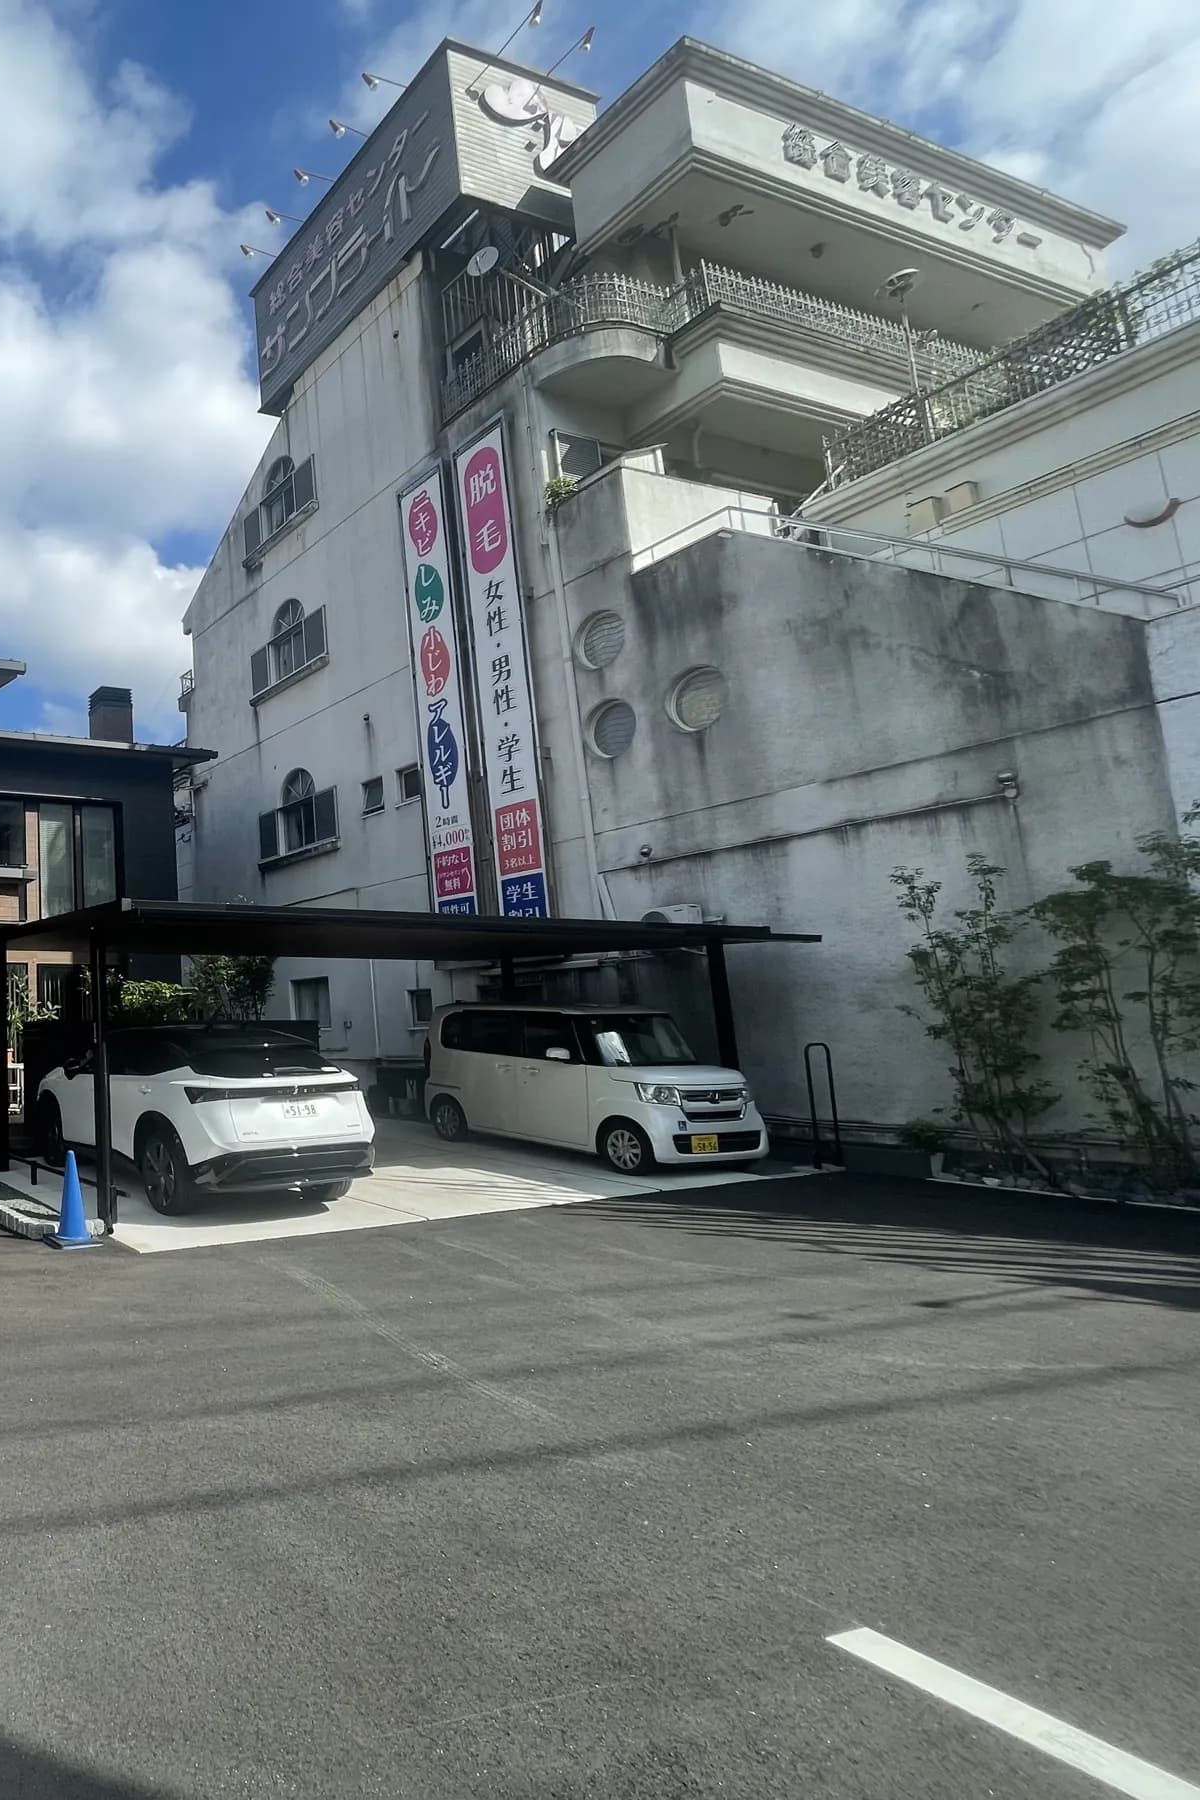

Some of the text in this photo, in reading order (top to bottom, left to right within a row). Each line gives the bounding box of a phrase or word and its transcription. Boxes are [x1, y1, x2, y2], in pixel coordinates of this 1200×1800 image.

[269, 111, 430, 316] 総合美容センター
[412, 490, 432, 556] ニキビ
[468, 463, 502, 553] 脱毛
[419, 565, 440, 622] しみ
[423, 627, 444, 697] 小じわ
[483, 580, 525, 795] 女性・男性・学生
[428, 699, 453, 810] アレルギー
[500, 808, 531, 832] 団体
[501, 828, 532, 852] 割引
[504, 854, 537, 869] 3名以上
[506, 882, 539, 904] 学生
